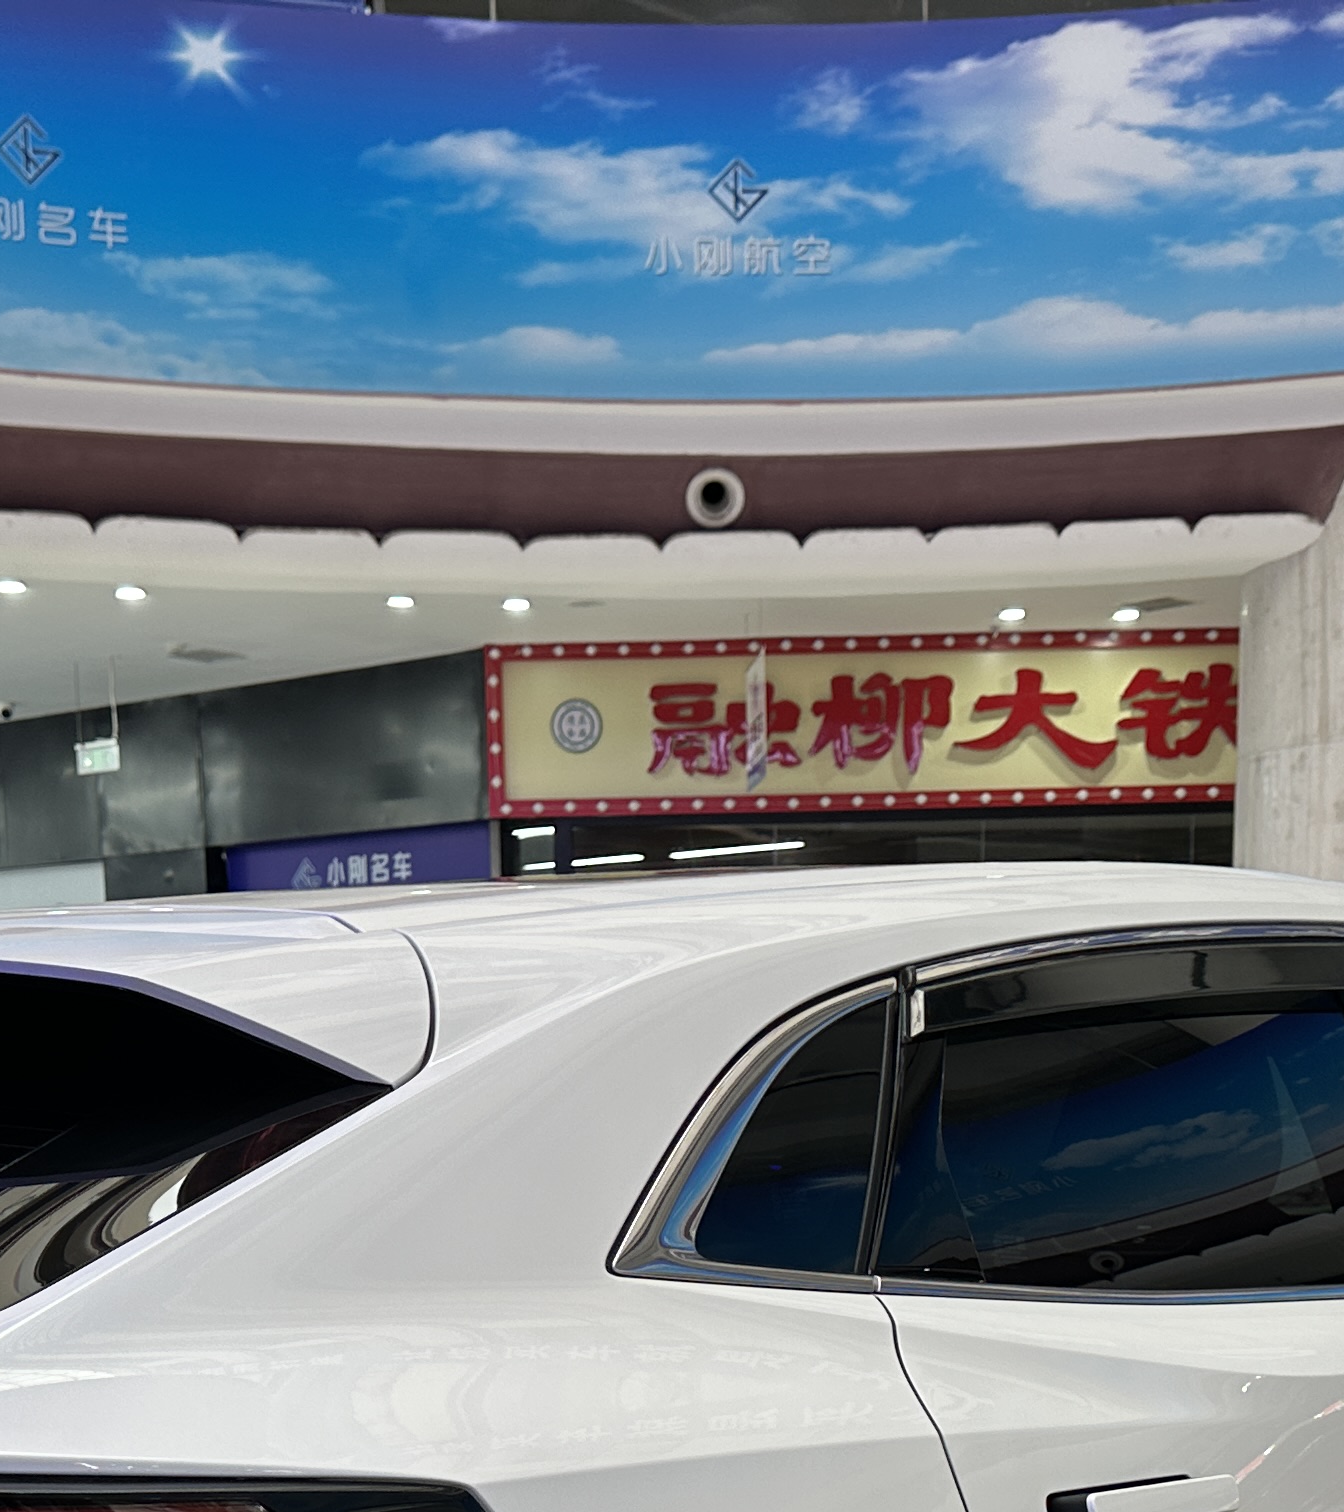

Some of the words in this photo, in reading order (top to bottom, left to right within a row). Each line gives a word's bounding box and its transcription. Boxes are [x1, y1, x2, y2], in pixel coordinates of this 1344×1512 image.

[644, 234, 832, 276] 小刚航空
[326, 851, 413, 887] 小刚名车
